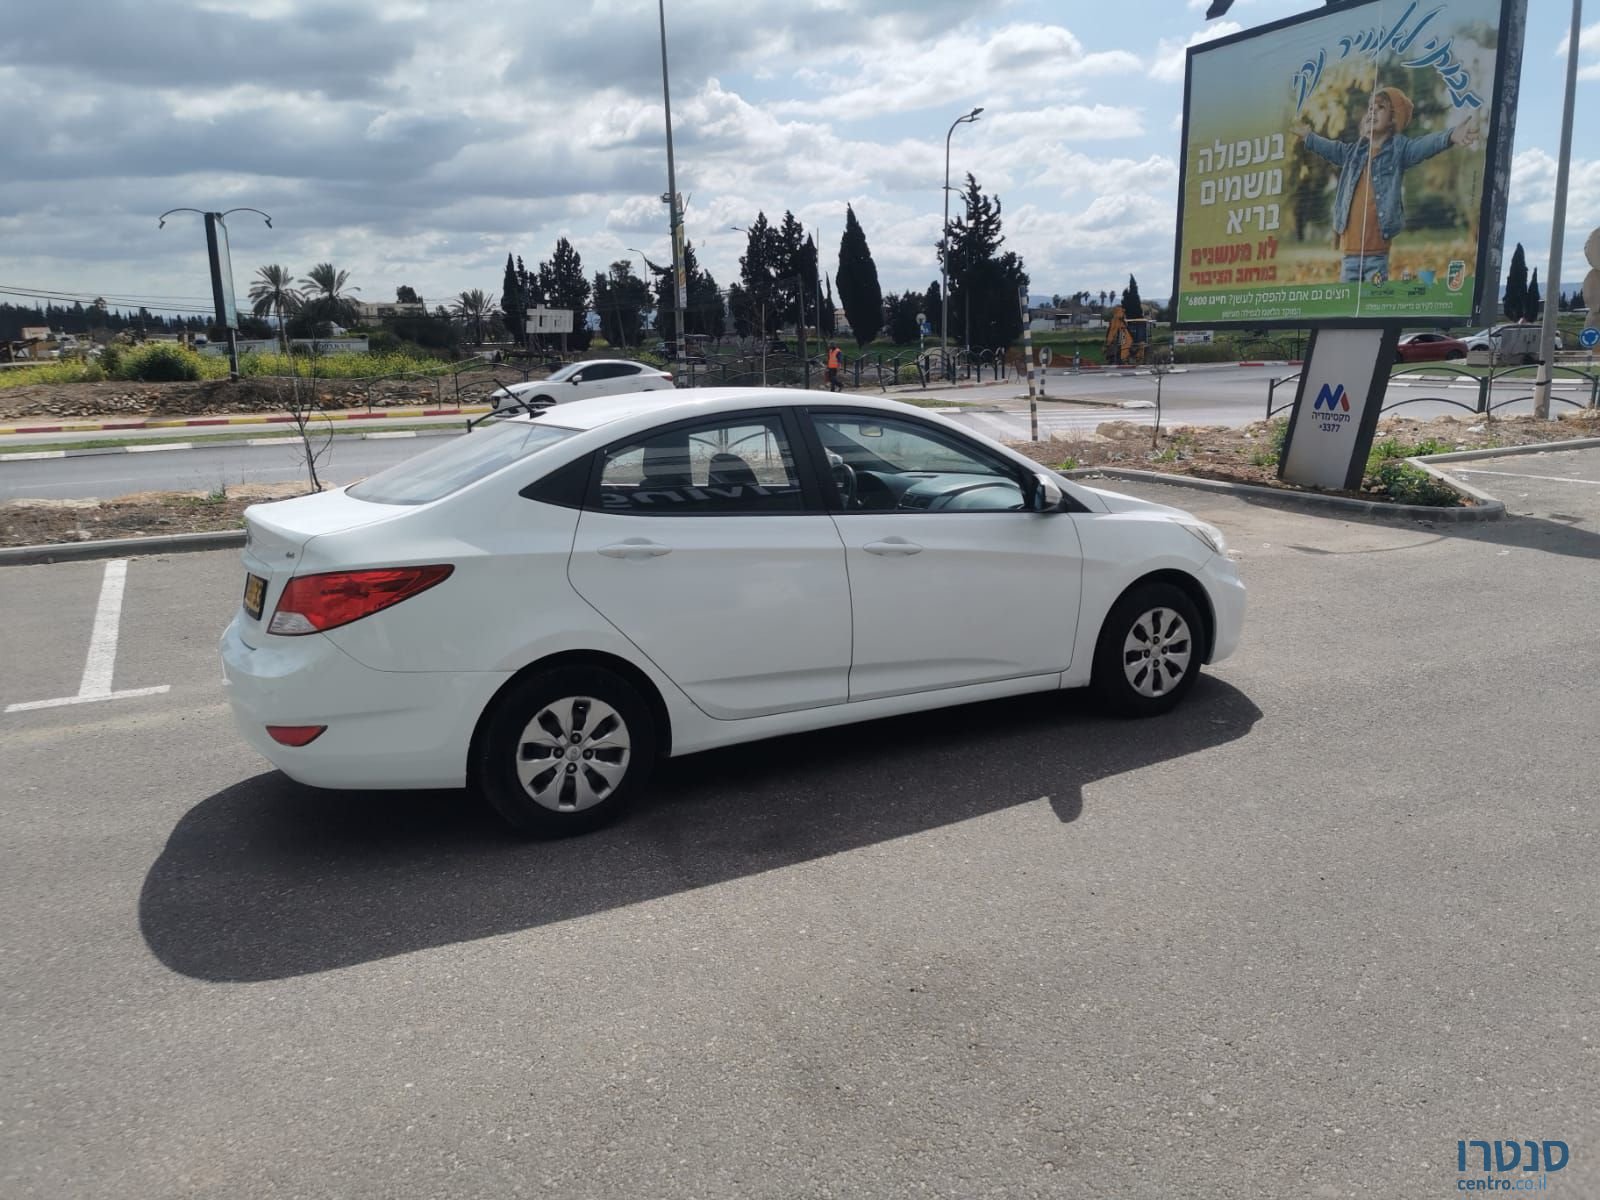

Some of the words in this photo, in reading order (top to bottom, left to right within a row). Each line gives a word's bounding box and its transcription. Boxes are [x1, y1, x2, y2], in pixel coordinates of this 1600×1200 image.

[1293, 48, 1325, 112] נקי
[1198, 132, 1285, 174] בעפולה
[1200, 168, 1283, 206] נושמים
[1226, 203, 1280, 235] בריא
[1190, 242, 1252, 266] מעשנים
[1257, 235, 1279, 261] לא
[1189, 269, 1233, 285] הציבורי
[1235, 265, 1277, 283] במרחב
[1209, 295, 1226, 305] חייגו
[1255, 288, 1287, 306] להפסק
[1288, 290, 1309, 302] אתם
[1311, 289, 1323, 301] גם
[1325, 288, 1350, 300] רוצים
[1311, 411, 1351, 423] מקסימדיה
